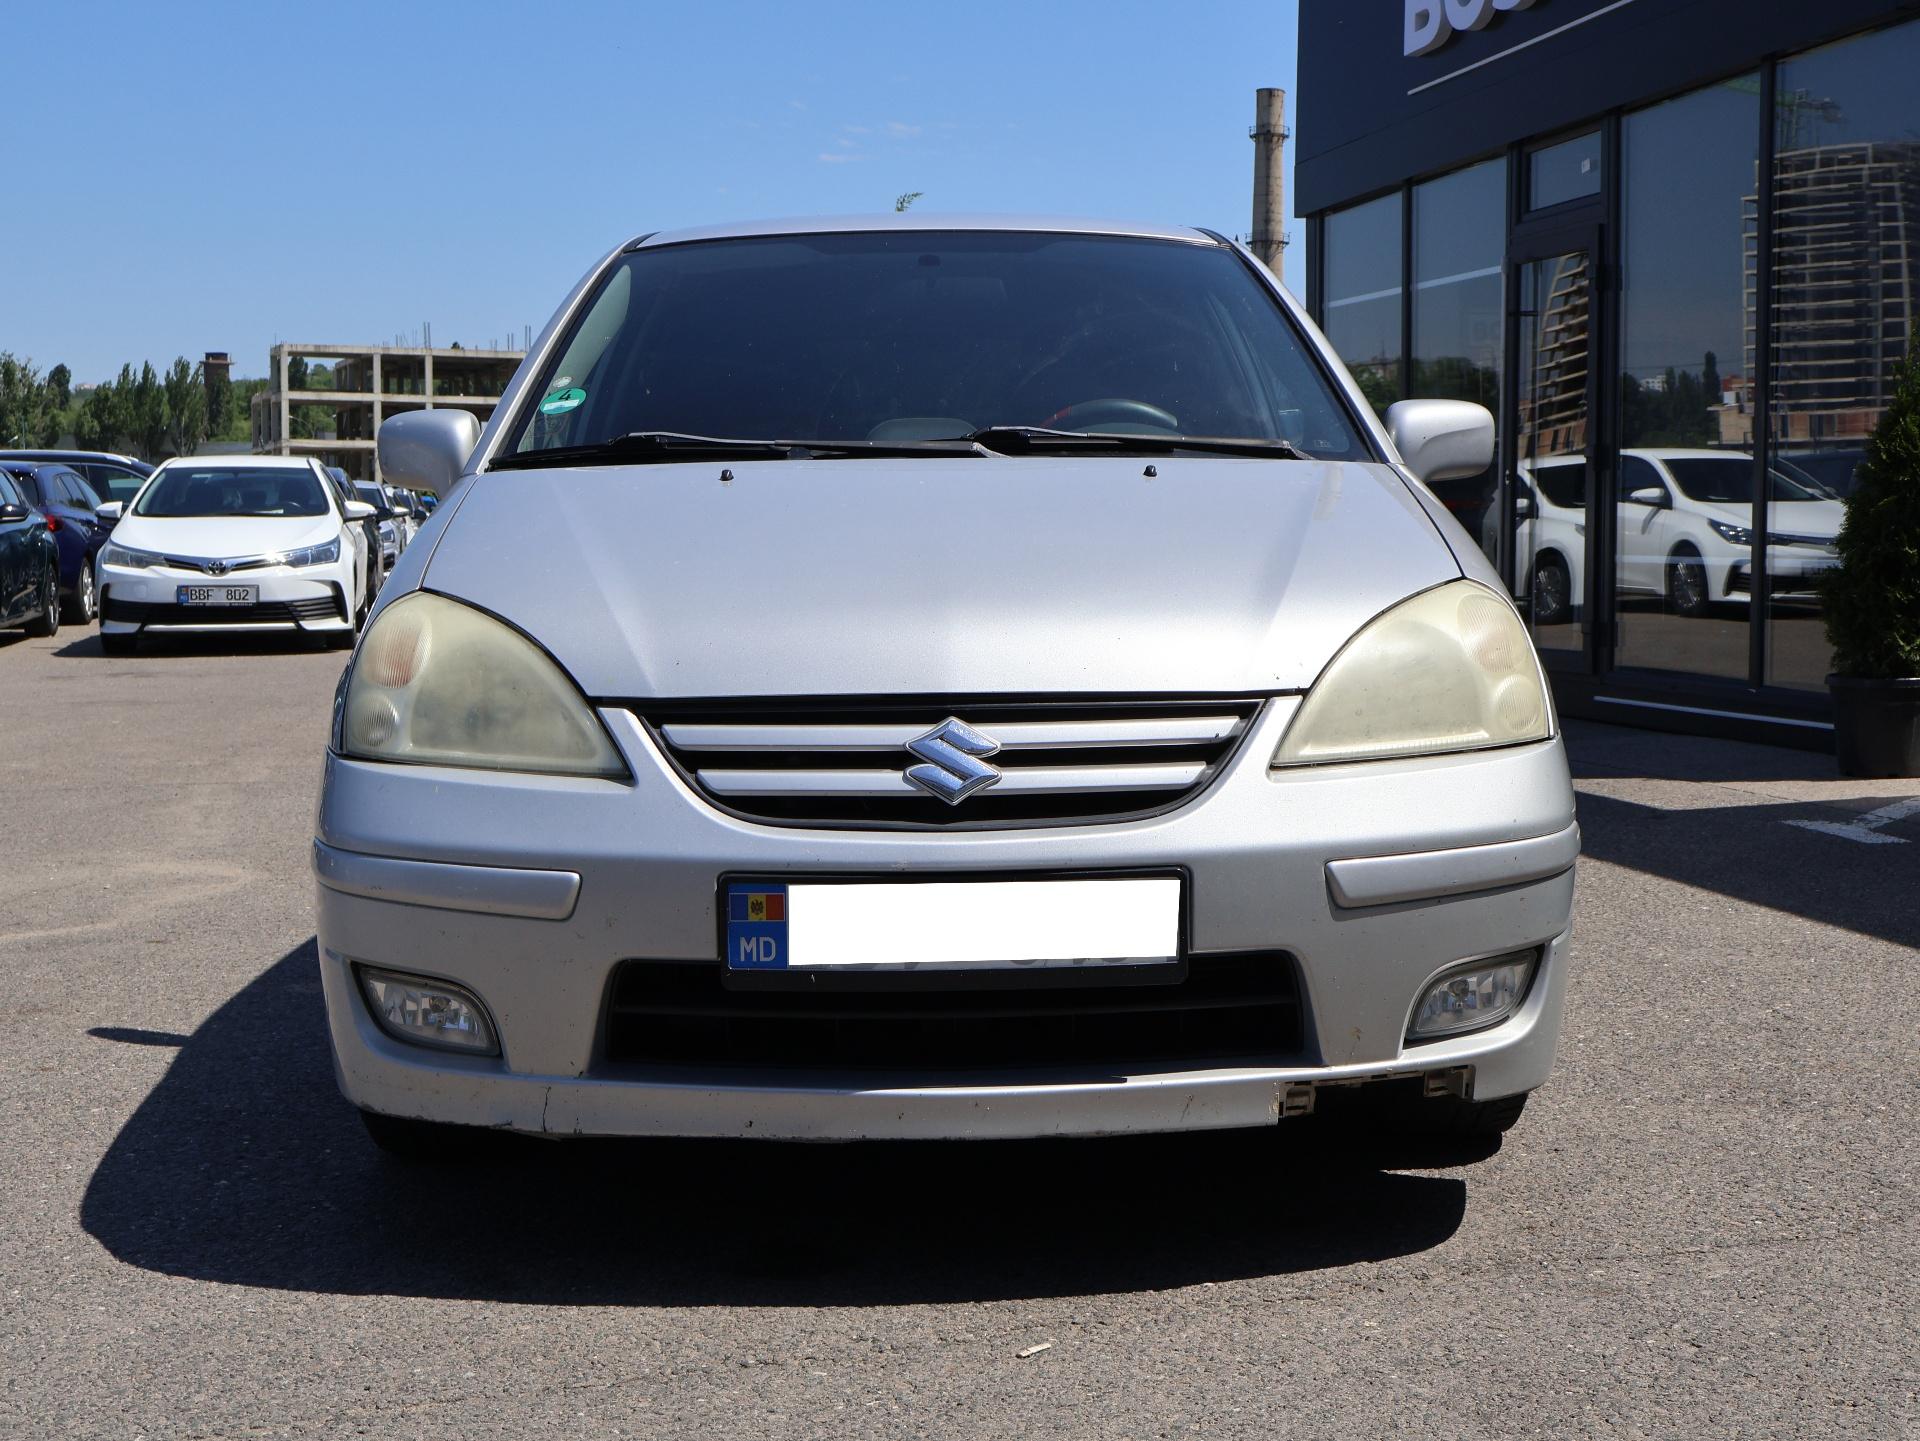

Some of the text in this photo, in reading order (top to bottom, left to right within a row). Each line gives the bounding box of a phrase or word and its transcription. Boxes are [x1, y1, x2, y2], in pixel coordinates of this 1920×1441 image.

[190, 588, 214, 601] BBF
[226, 588, 249, 601] 802
[740, 936, 776, 962] MD
